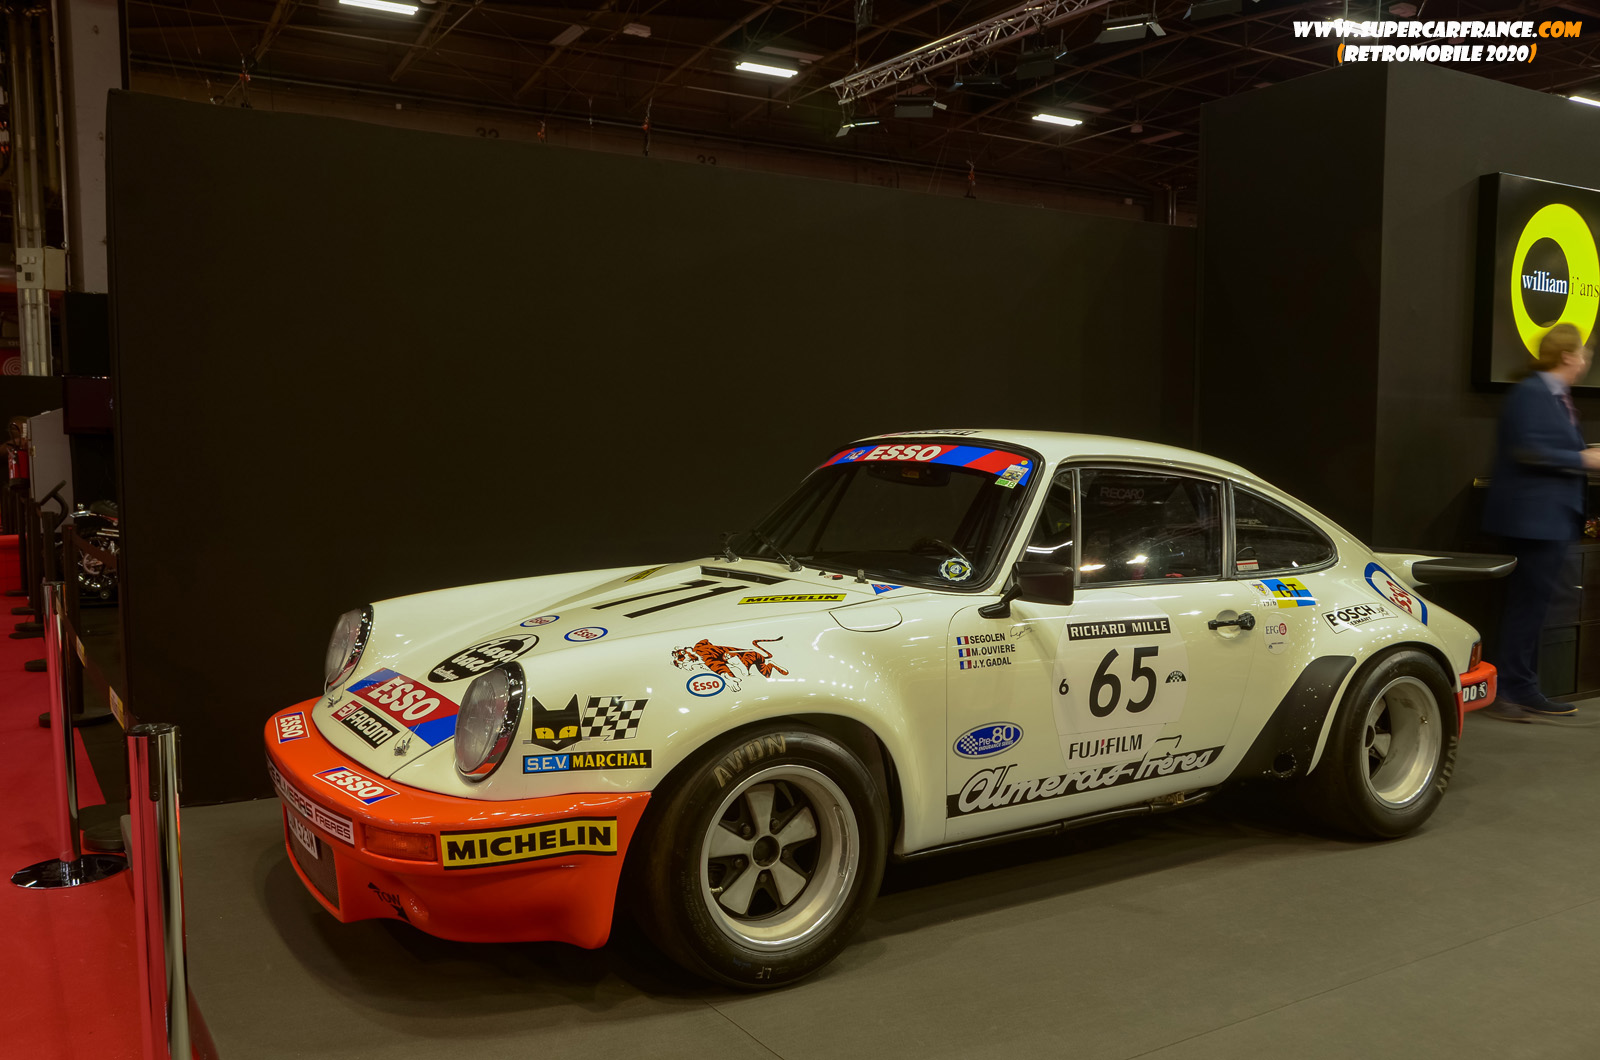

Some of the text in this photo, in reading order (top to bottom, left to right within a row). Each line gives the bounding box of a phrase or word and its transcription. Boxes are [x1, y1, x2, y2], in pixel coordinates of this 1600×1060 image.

[1521, 269, 1568, 295] william
[864, 445, 942, 461] ESSO
[1099, 486, 1145, 500] RECARO
[745, 594, 839, 603] MICHELIN
[1276, 583, 1302, 599] GT
[969, 632, 1006, 645] SEGOLEN
[1070, 619, 1168, 638] RICHARD MILLE
[1265, 624, 1279, 635] EFG
[451, 648, 499, 673] back
[1058, 678, 1070, 696] 6
[1088, 645, 1159, 718] 65
[366, 676, 441, 722] ESSO
[278, 714, 303, 739] ESSO
[345, 709, 393, 745] FACOM
[1068, 733, 1143, 760] FUJIFILM
[526, 750, 648, 771] S.E.V. MARCHAL
[712, 733, 787, 789] AVON
[324, 770, 380, 799] ESSO
[446, 826, 612, 861] MICHELIN
[373, 890, 401, 906] TOW
